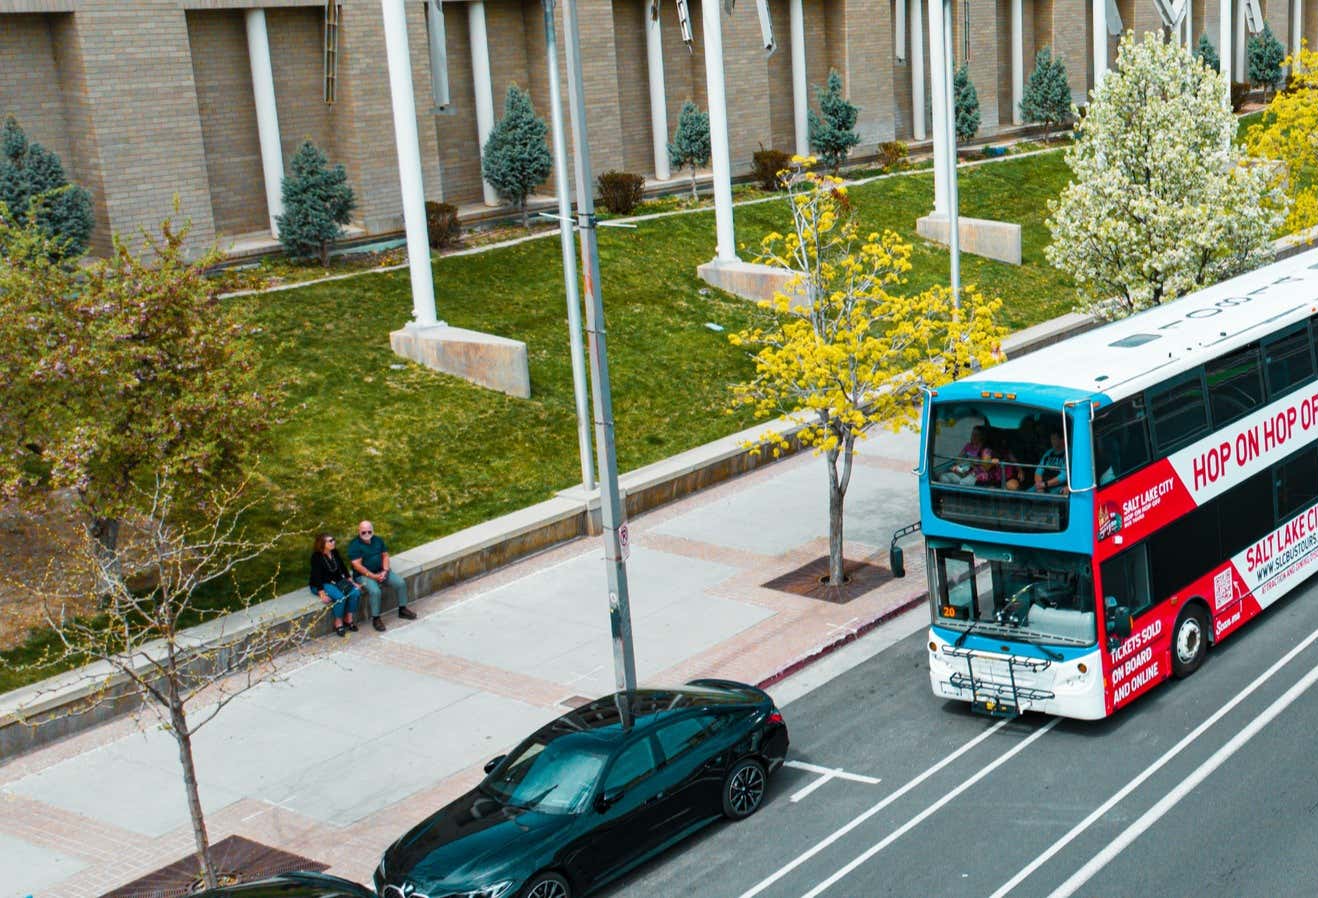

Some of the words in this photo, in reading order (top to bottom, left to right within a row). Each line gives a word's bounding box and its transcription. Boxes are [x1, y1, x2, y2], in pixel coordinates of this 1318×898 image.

[1193, 442, 1231, 491] HOP
[1235, 429, 1260, 466] ON
[1264, 407, 1297, 452] HOP
[1123, 495, 1140, 515] SALT
[1140, 485, 1159, 506] LAKE
[1159, 477, 1174, 496] CITY
[1246, 534, 1274, 572] SALT
[1277, 518, 1306, 553] LAKE
[943, 606, 955, 617] 20
[1111, 632, 1141, 664] TICKETS
[1141, 619, 1162, 643] SOLD
[1112, 666, 1124, 685] ON
[1125, 646, 1152, 676] BOARD
[1113, 682, 1131, 705] AND
[1131, 661, 1159, 692] ONLINE
